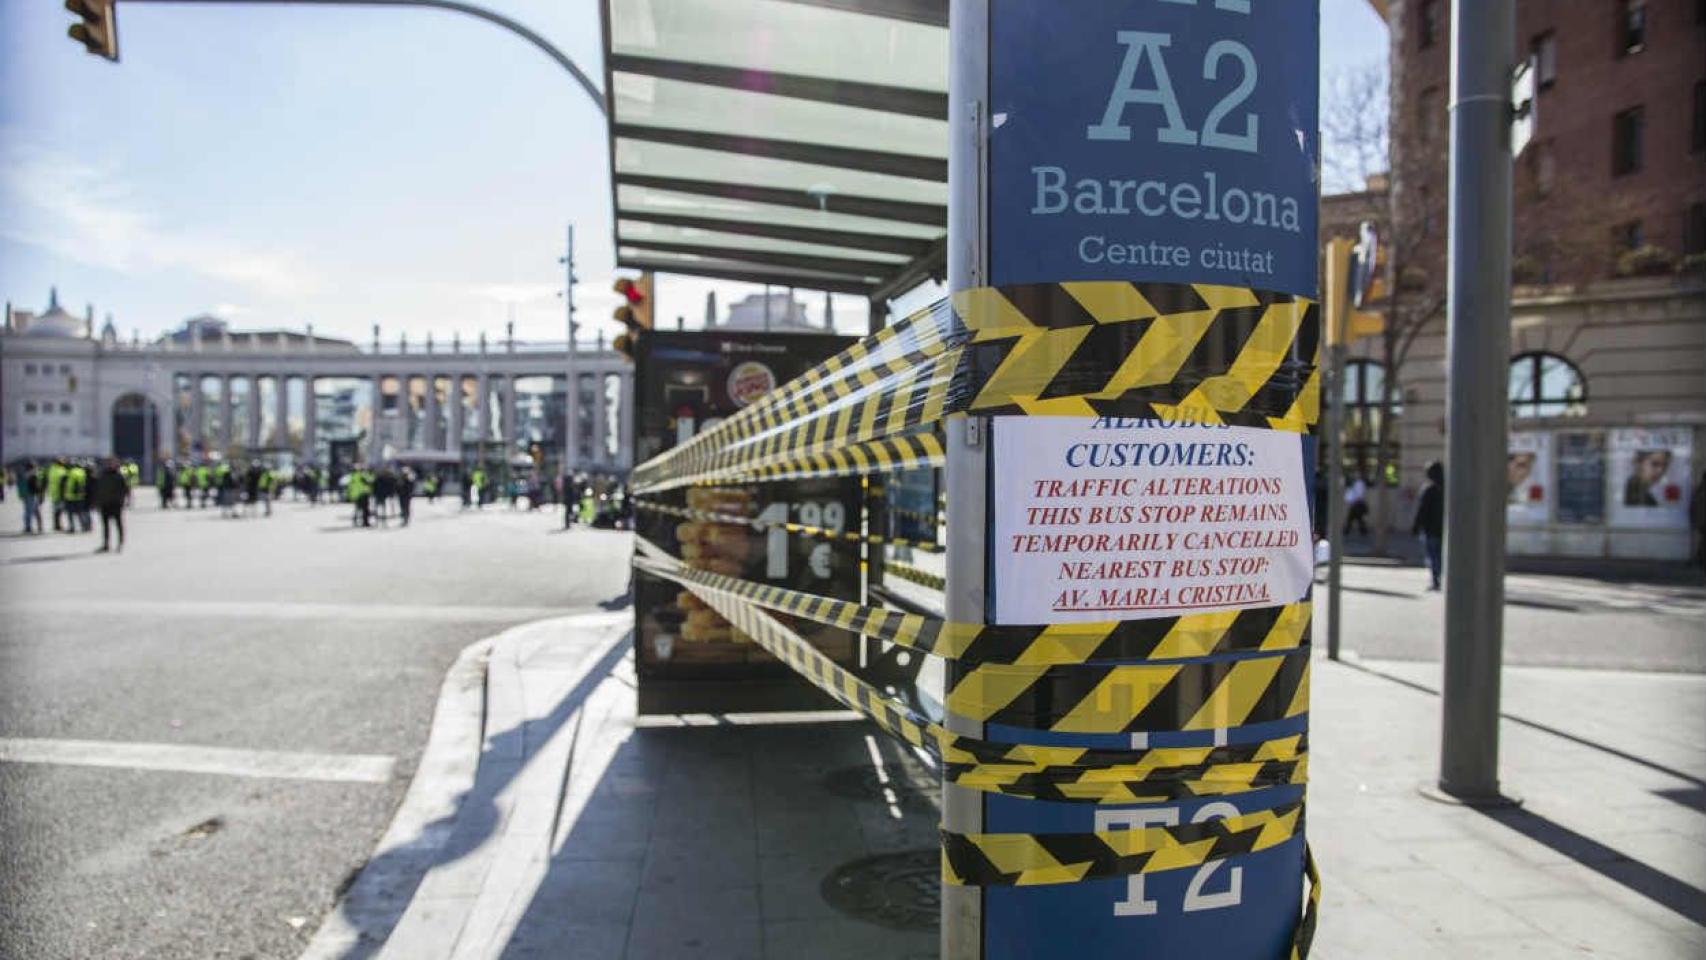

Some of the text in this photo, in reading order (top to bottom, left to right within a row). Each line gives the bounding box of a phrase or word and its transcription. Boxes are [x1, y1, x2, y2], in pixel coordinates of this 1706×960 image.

[1087, 30, 1258, 152] A2
[1030, 166, 1300, 232] Barcelona
[1078, 236, 1275, 275] Centre ciutat
[1066, 442, 1254, 468] CUSTOMERS:
[1034, 477, 1282, 497] TRAFFIC ALTERATIONS
[1027, 503, 1287, 525] THIS BUS STOP REMAINS
[1012, 530, 1298, 553] TEMPORARILY CANCELLED
[1058, 557, 1269, 580] NEAREST BUS STOP:
[1052, 589, 1089, 607] AV.
[1097, 587, 1170, 607] MARIA
[1094, 802, 1243, 916] T2
